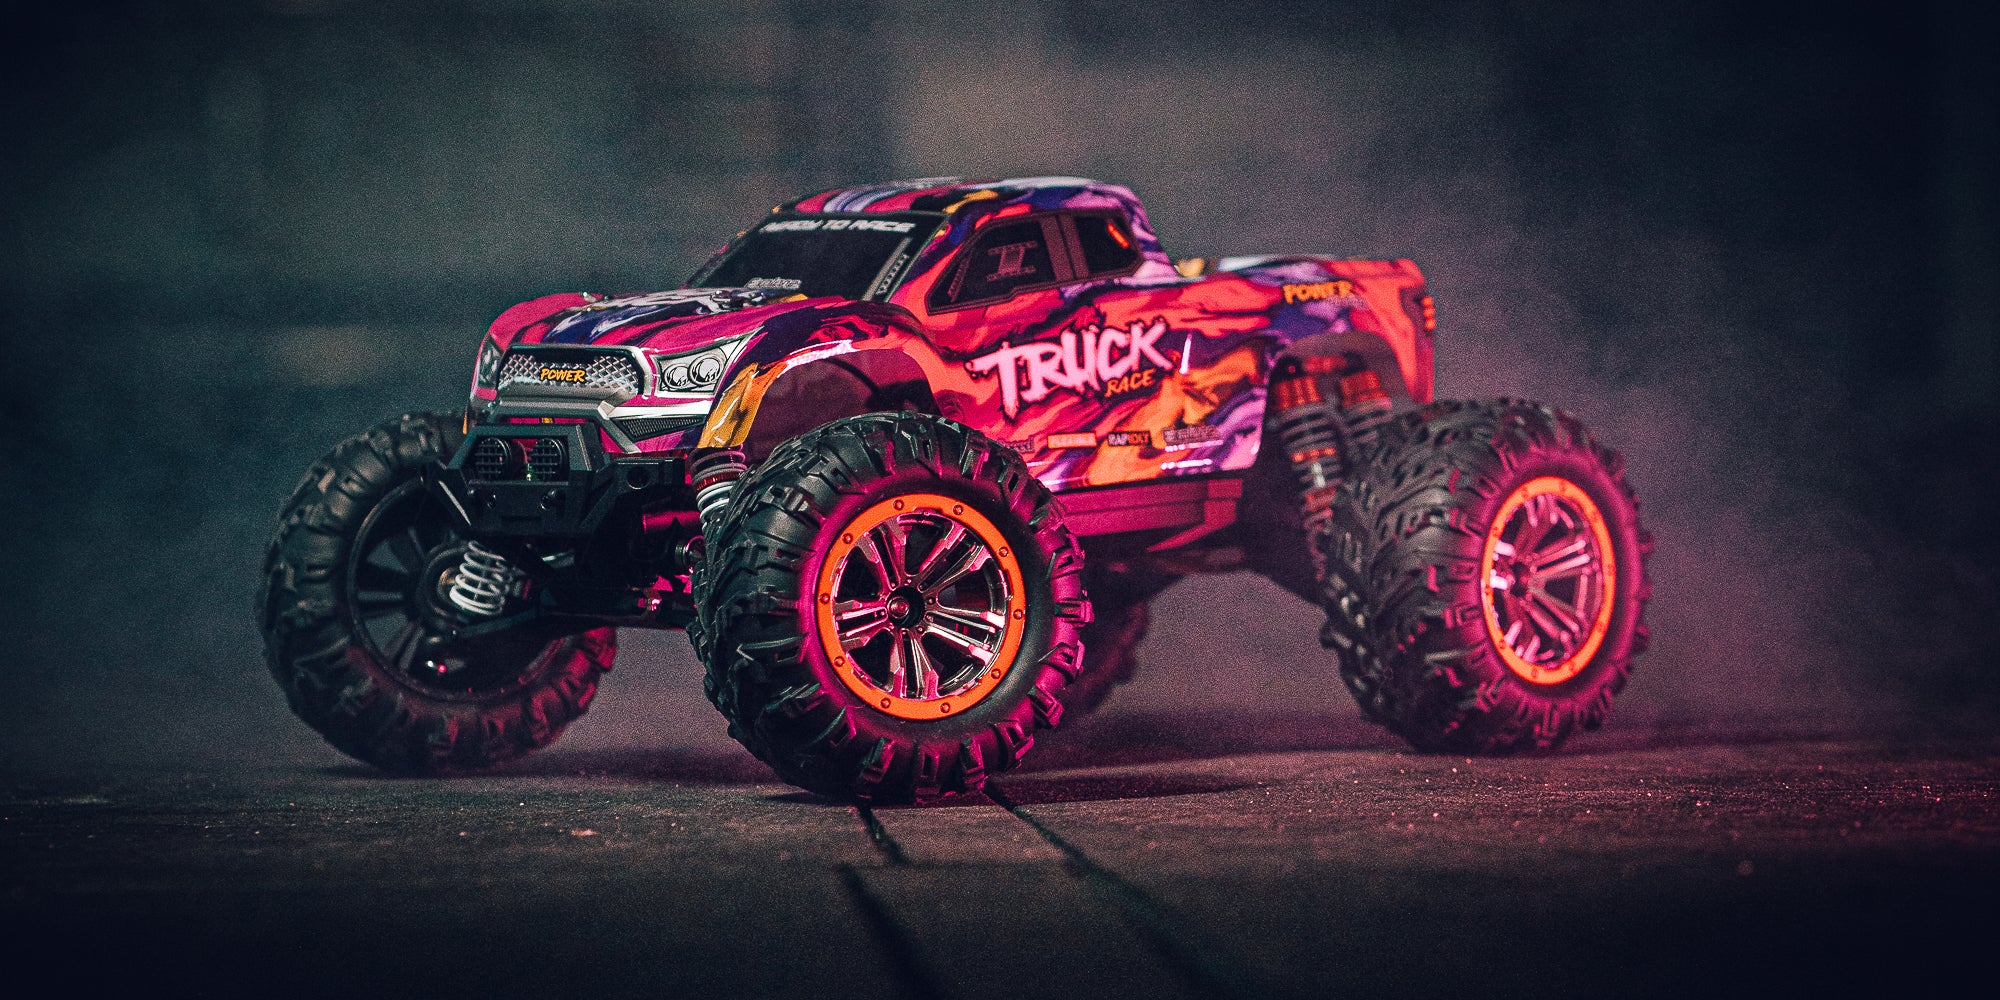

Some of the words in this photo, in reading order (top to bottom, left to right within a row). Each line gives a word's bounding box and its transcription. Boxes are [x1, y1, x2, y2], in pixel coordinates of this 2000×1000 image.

[821, 219, 852, 231] TO
[848, 220, 916, 233] RACE
[1283, 281, 1352, 303] POWER
[540, 368, 585, 382] POWER
[969, 318, 1173, 418] TRUCK
[1105, 371, 1156, 397] RACE
